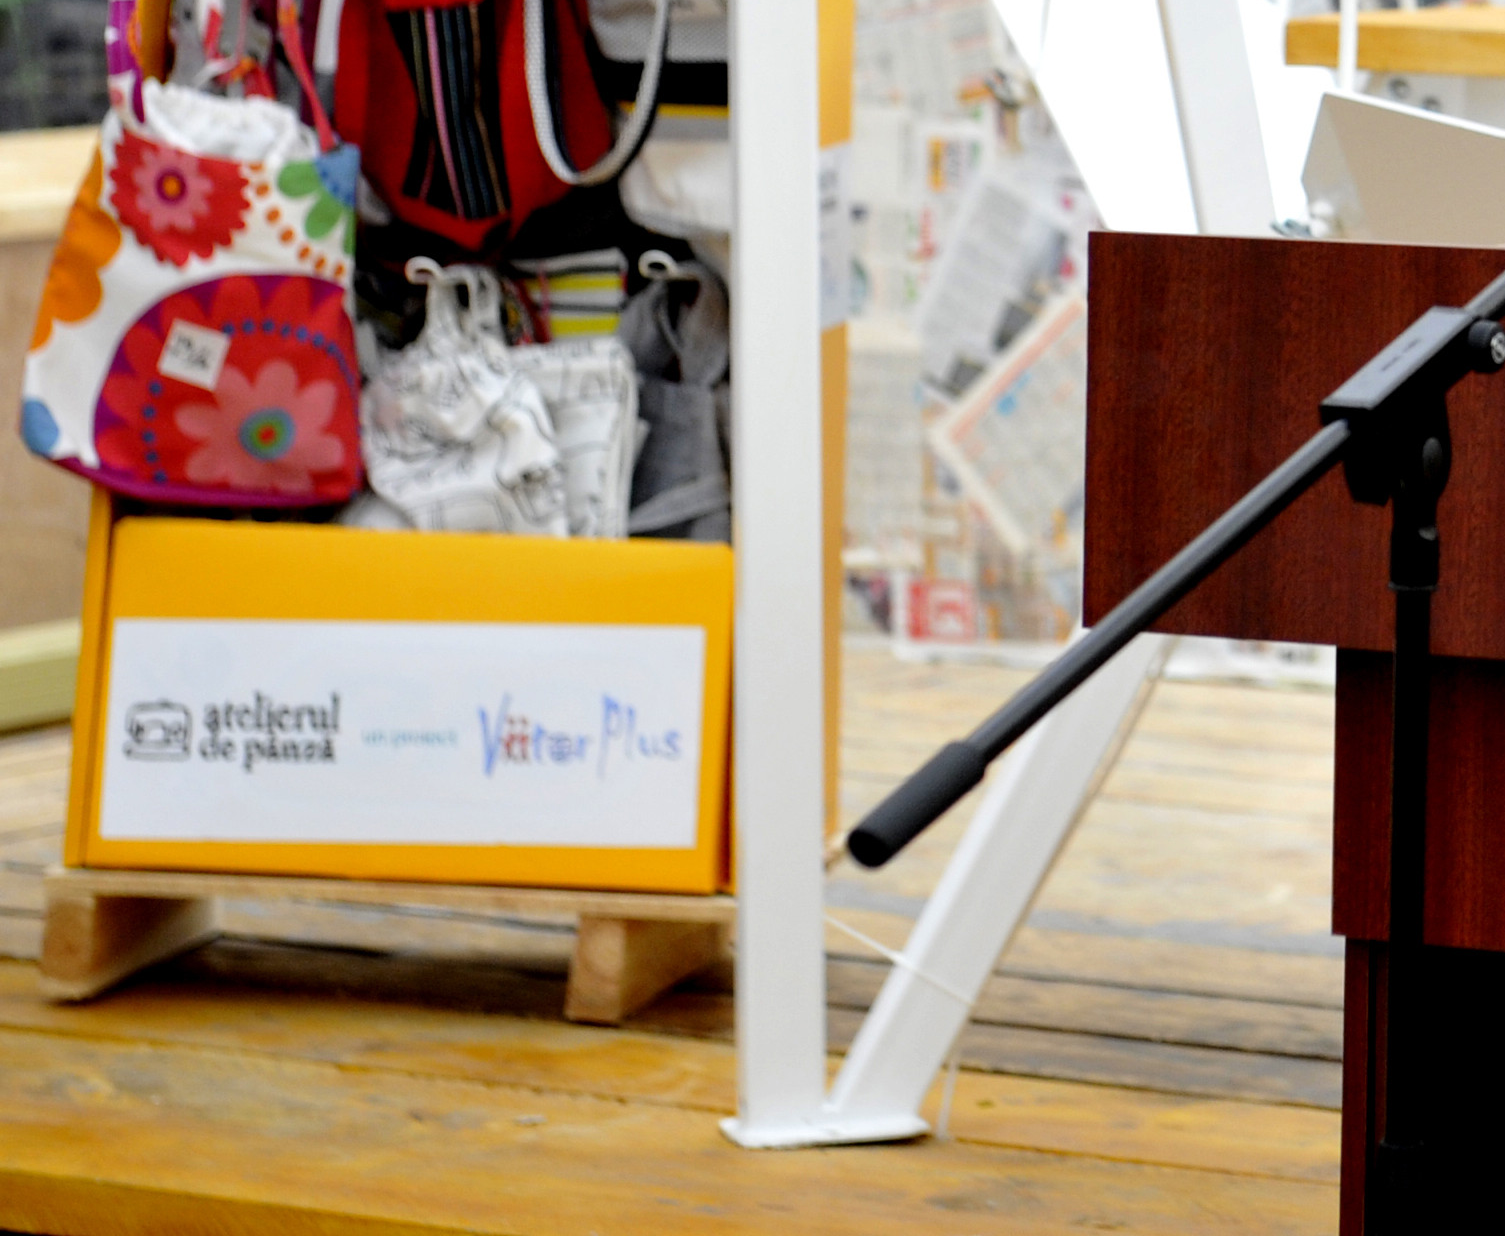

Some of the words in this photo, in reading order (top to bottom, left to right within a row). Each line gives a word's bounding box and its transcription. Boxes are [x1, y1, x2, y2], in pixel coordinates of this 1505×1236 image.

[203, 690, 340, 737] atelierul
[598, 693, 684, 780] Plus
[200, 734, 236, 760] de
